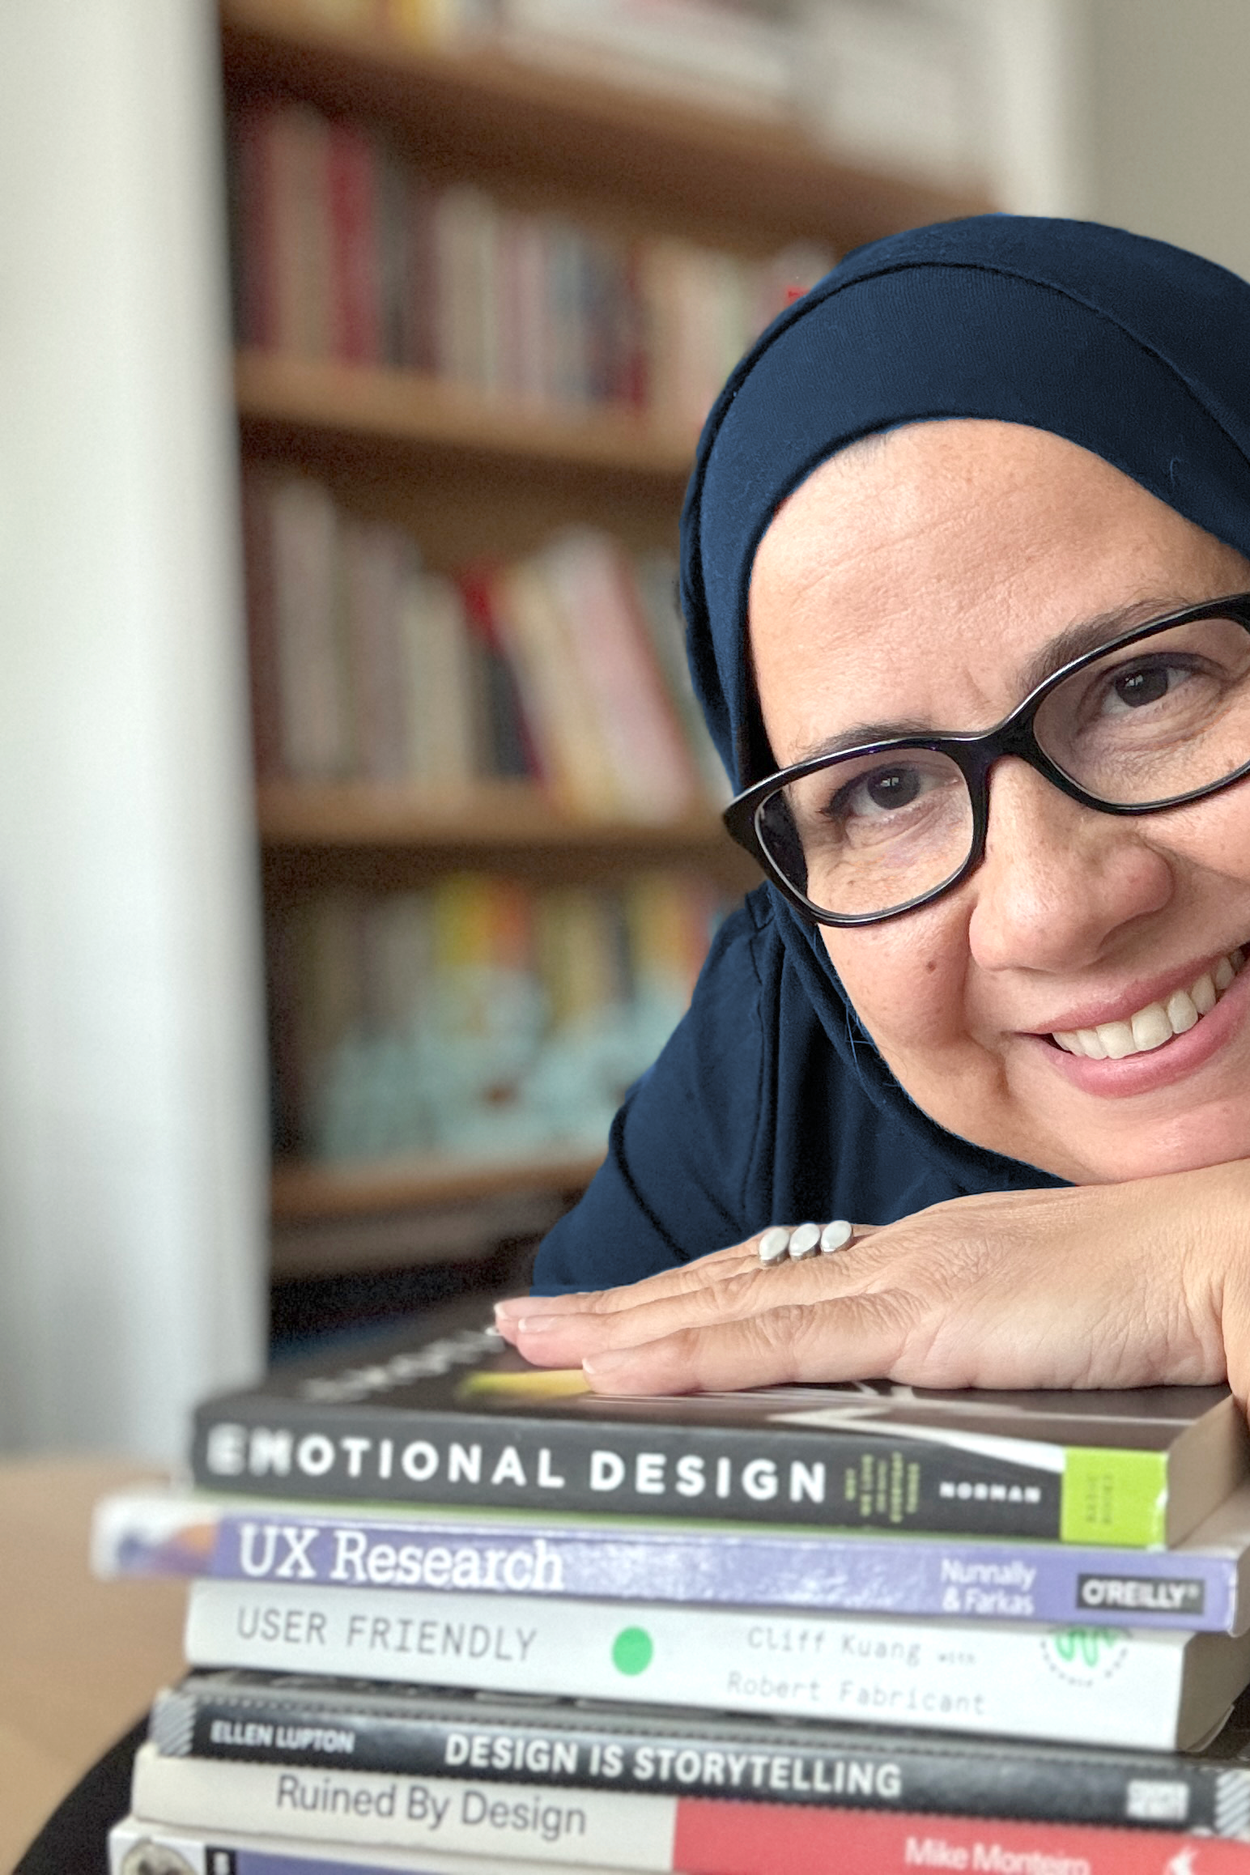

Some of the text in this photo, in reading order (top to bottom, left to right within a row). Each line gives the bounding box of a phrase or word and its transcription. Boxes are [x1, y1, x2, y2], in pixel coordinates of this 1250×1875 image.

[205, 1423, 565, 1489] EMOTIONAL
[589, 1451, 826, 1503] DESIGN
[939, 1481, 1042, 1504] NORMAN
[239, 1523, 565, 1591] UX Research
[941, 1558, 1037, 1591] Nunnally
[942, 1586, 1036, 1616] & Farkas
[236, 1605, 538, 1663] USER FRIENDLY
[747, 1625, 826, 1653] Cliff
[841, 1633, 921, 1668] Kuang
[727, 1670, 986, 1716] Robert Fabricant
[210, 1719, 356, 1754] ELLEN LUPTON
[445, 1733, 902, 1799] DESIGN IS STORYTELLING
[276, 1774, 587, 1843] Ruined By Design
[904, 1836, 969, 1870] Mike
